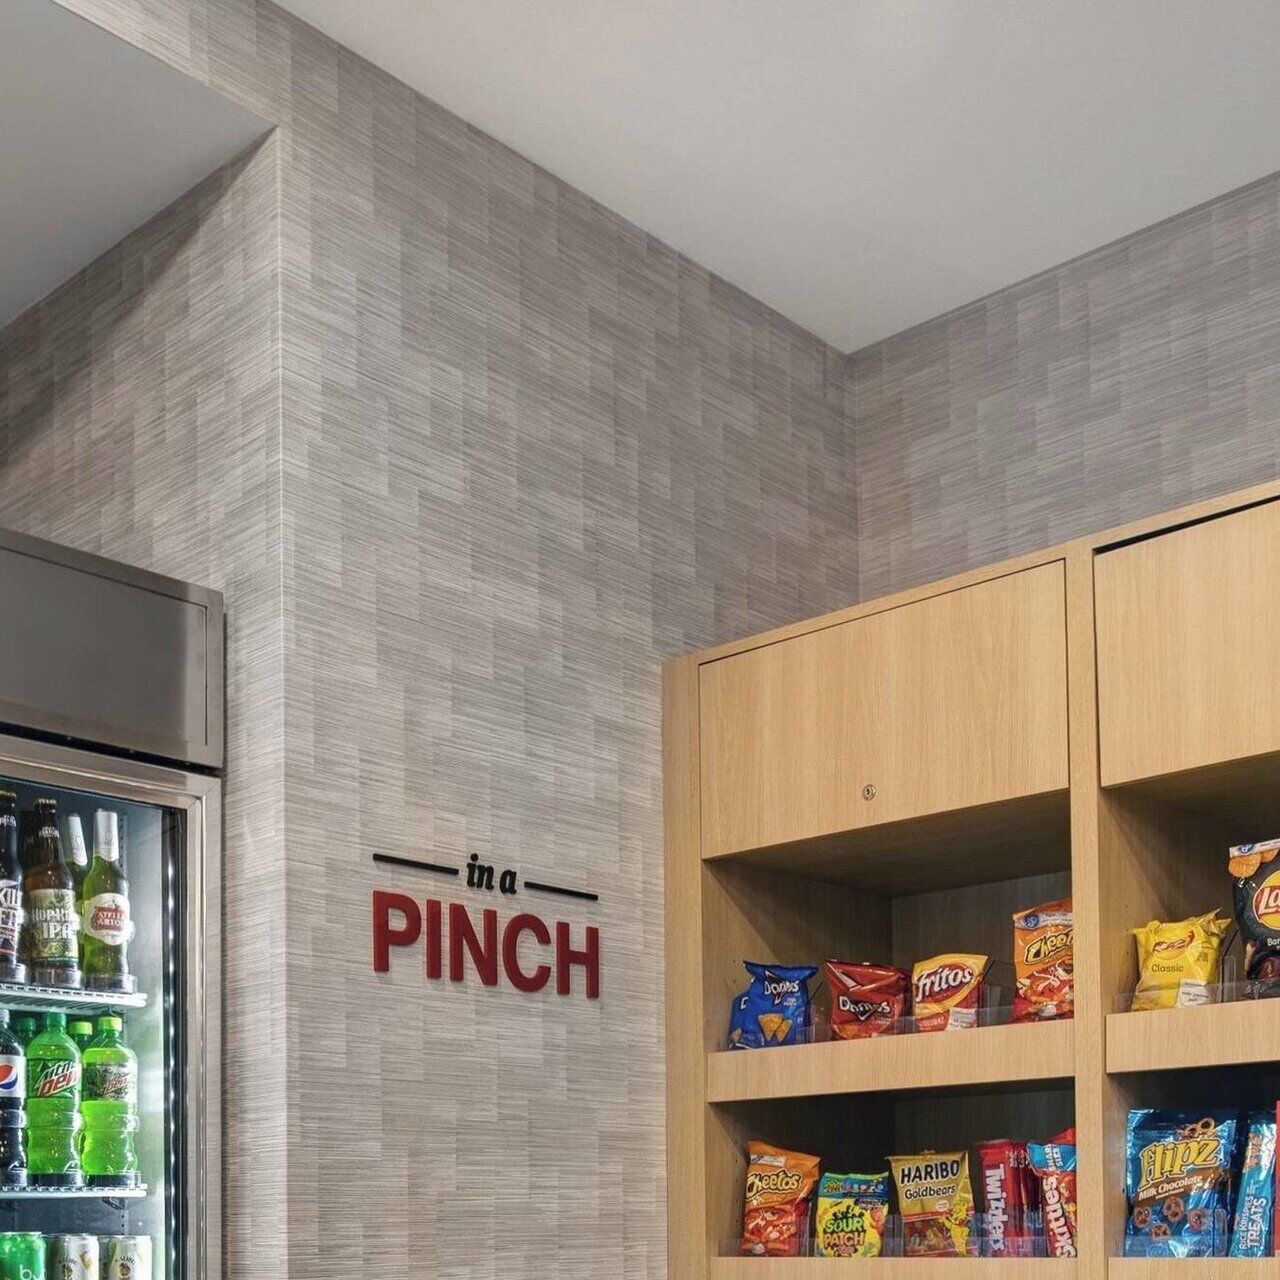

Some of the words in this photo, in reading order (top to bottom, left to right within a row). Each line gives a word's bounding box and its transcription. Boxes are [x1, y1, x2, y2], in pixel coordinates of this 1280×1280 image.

[466, 853, 494, 891] in
[500, 868, 518, 894] a
[373, 890, 600, 999] PINCH
[915, 964, 973, 1001] Fritos
[1151, 963, 1185, 973] Classic
[839, 997, 891, 1014] Doritos
[900, 1159, 960, 1185] HARIBO
[1139, 1137, 1221, 1191] Flipz
[747, 1169, 801, 1202] Cheetos
[905, 1184, 956, 1200] Goldbears
[1138, 1190, 1157, 1200] Milk
[1158, 1175, 1203, 1192] Chocolate
[985, 1164, 1006, 1252] Twizzlers
[1247, 1196, 1268, 1249] TREATS
[823, 1231, 865, 1246] PATCH
[826, 1218, 864, 1233] SOUR
